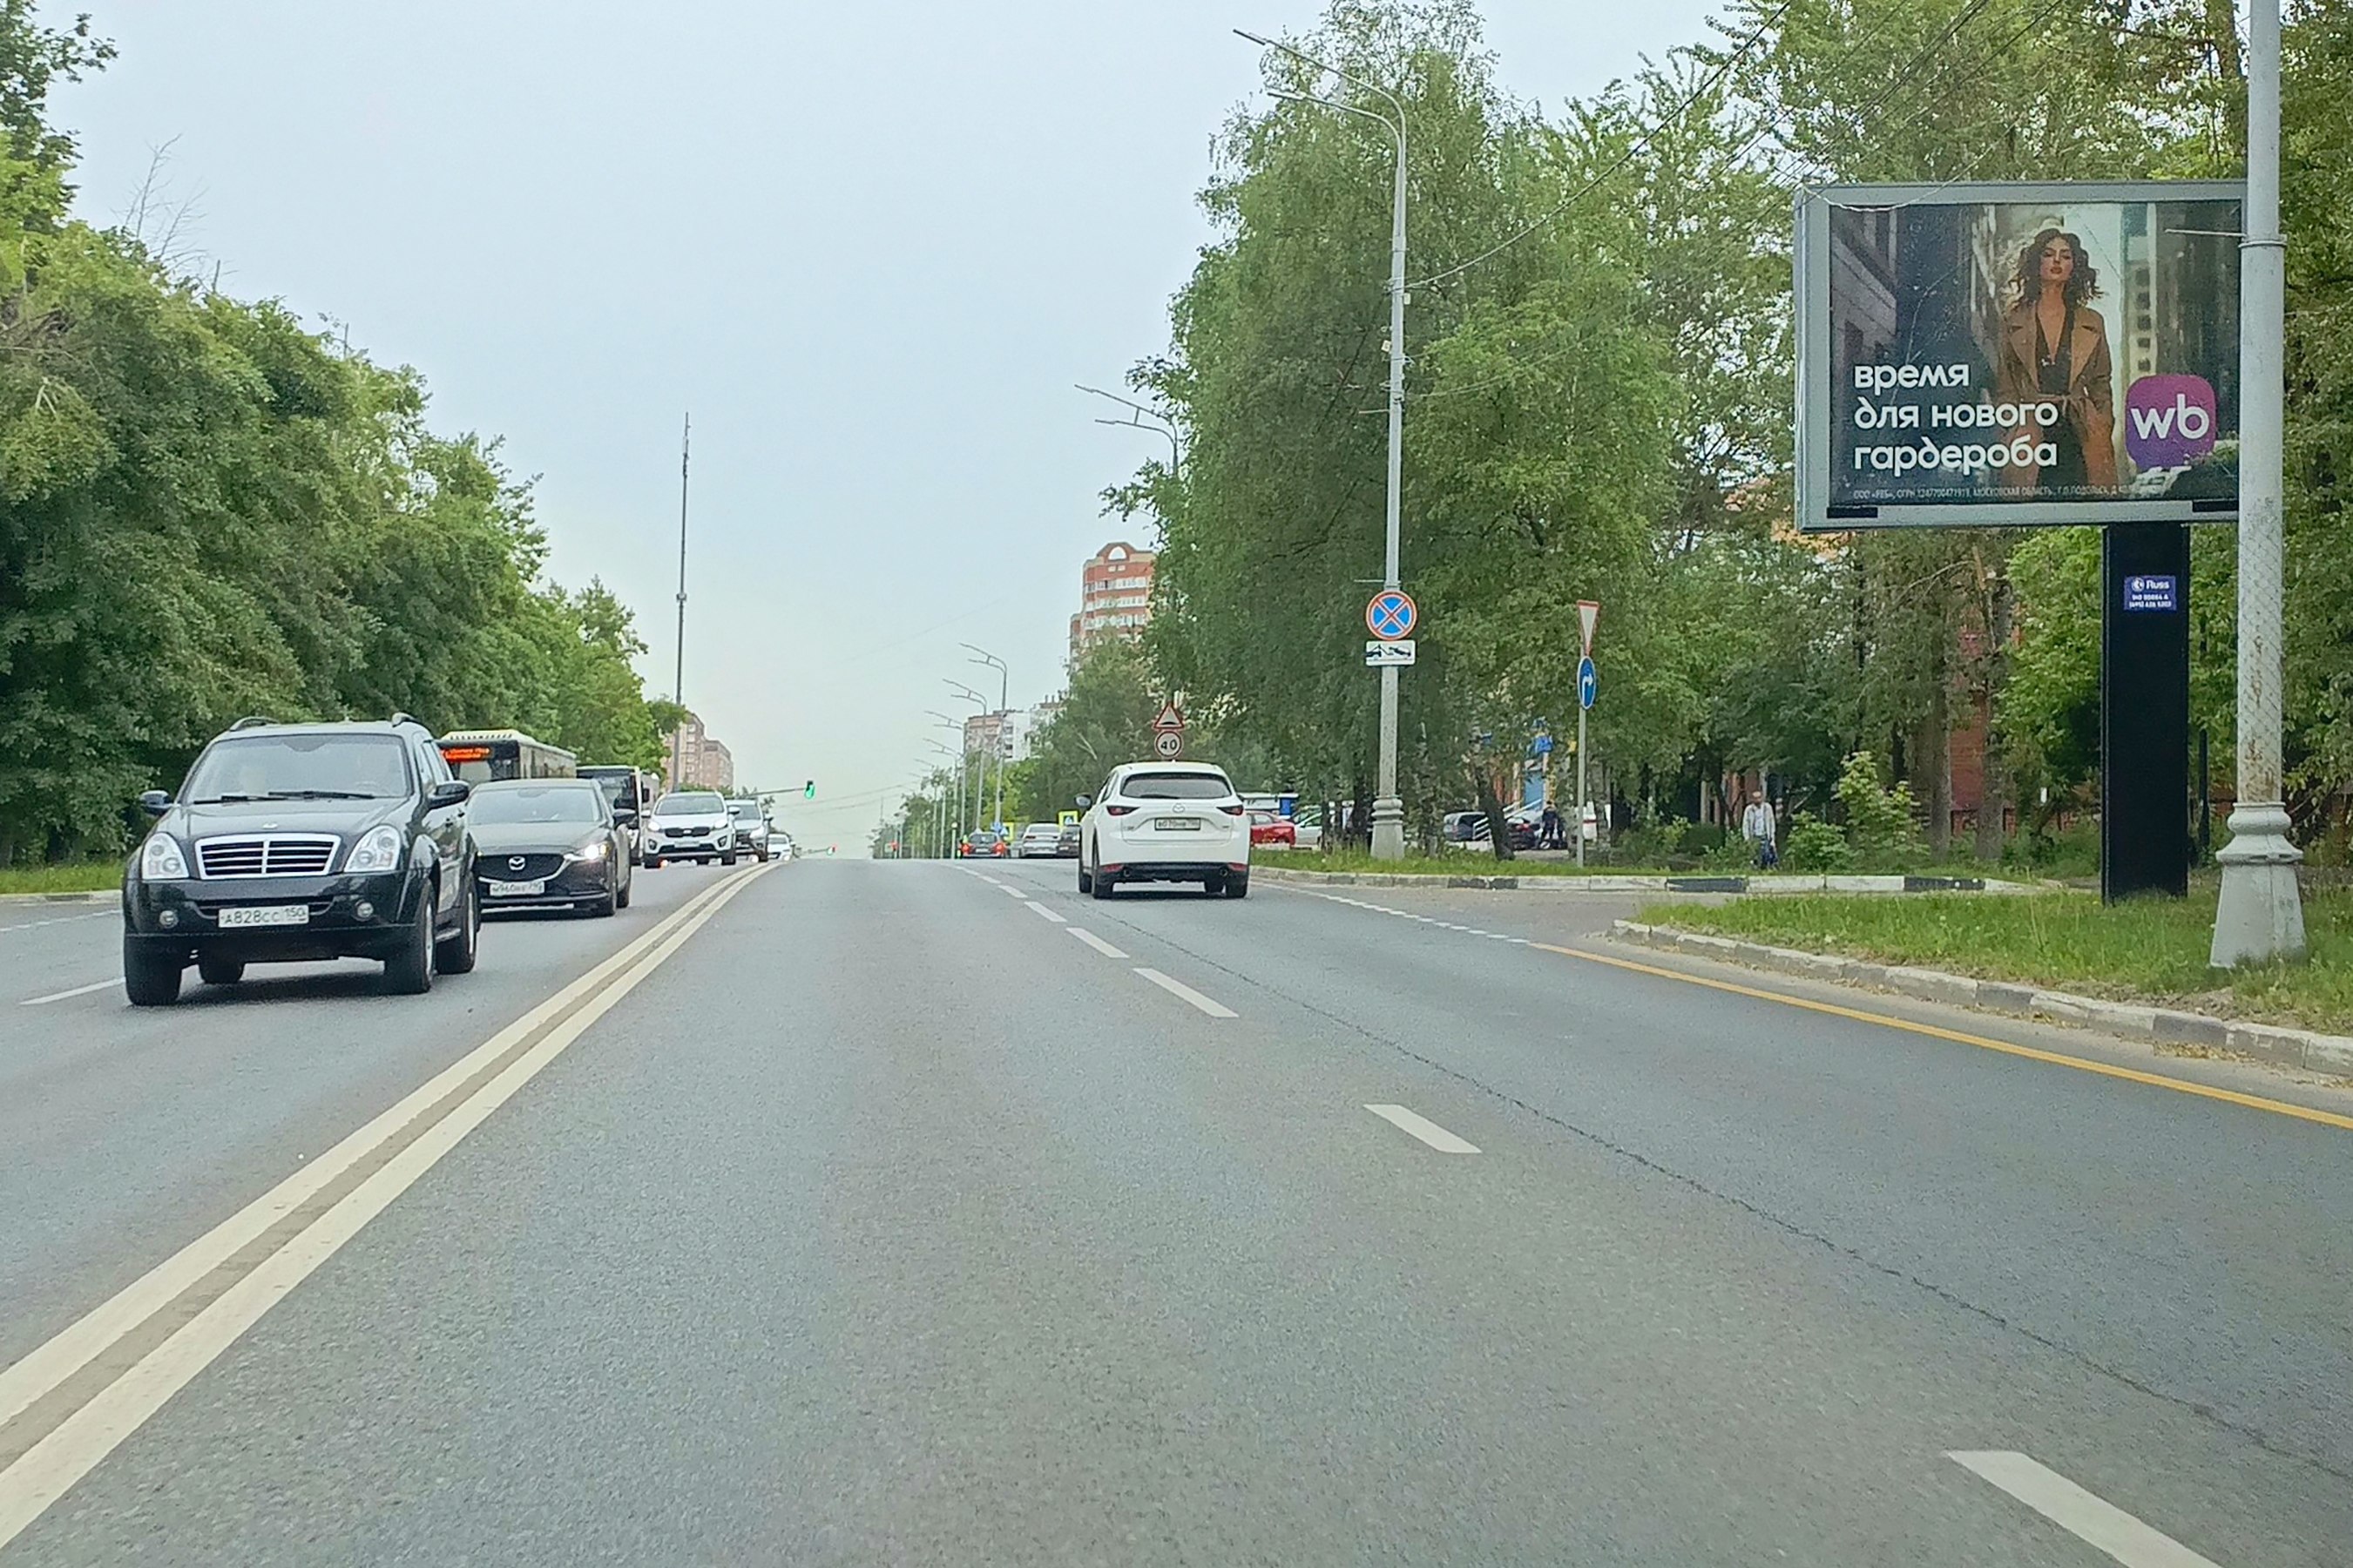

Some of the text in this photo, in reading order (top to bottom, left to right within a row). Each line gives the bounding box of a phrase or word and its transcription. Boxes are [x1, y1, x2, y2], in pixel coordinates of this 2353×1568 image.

[1854, 363, 1970, 396] время
[1854, 396, 2059, 429] для нового
[2130, 393, 2210, 440] wb
[1854, 435, 2058, 477] гардероба
[1160, 739, 1178, 750] 40
[225, 909, 280, 924] А828СС
